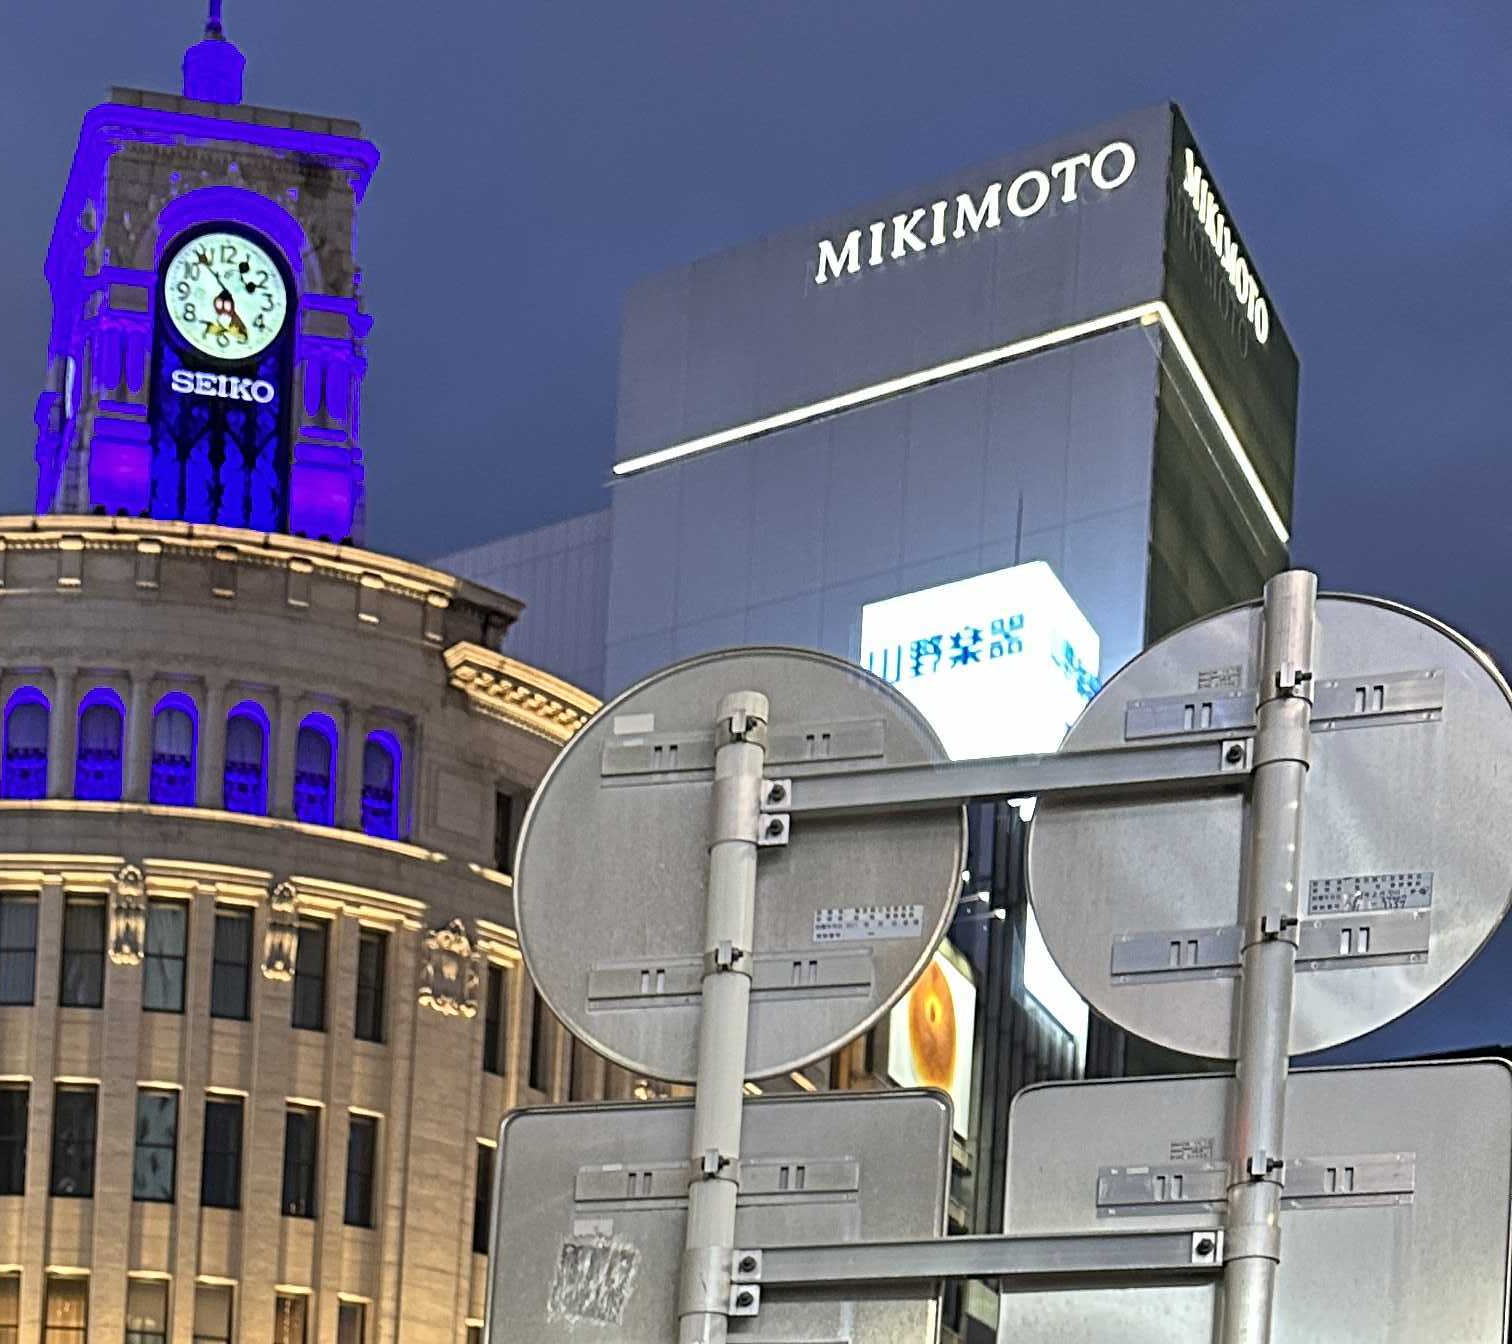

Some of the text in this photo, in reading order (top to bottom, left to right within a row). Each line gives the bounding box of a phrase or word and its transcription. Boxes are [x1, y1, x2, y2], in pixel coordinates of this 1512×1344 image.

[814, 141, 1136, 284] MIKIMOTO
[220, 245, 238, 265] 12
[1182, 146, 1270, 345] MIKIMOTO
[183, 261, 200, 282] 10
[255, 269, 268, 289] 2
[177, 280, 191, 301] 9
[183, 302, 196, 322] 8
[261, 292, 274, 312] 3
[253, 313, 265, 332] 4
[171, 368, 276, 403] SEIKO
